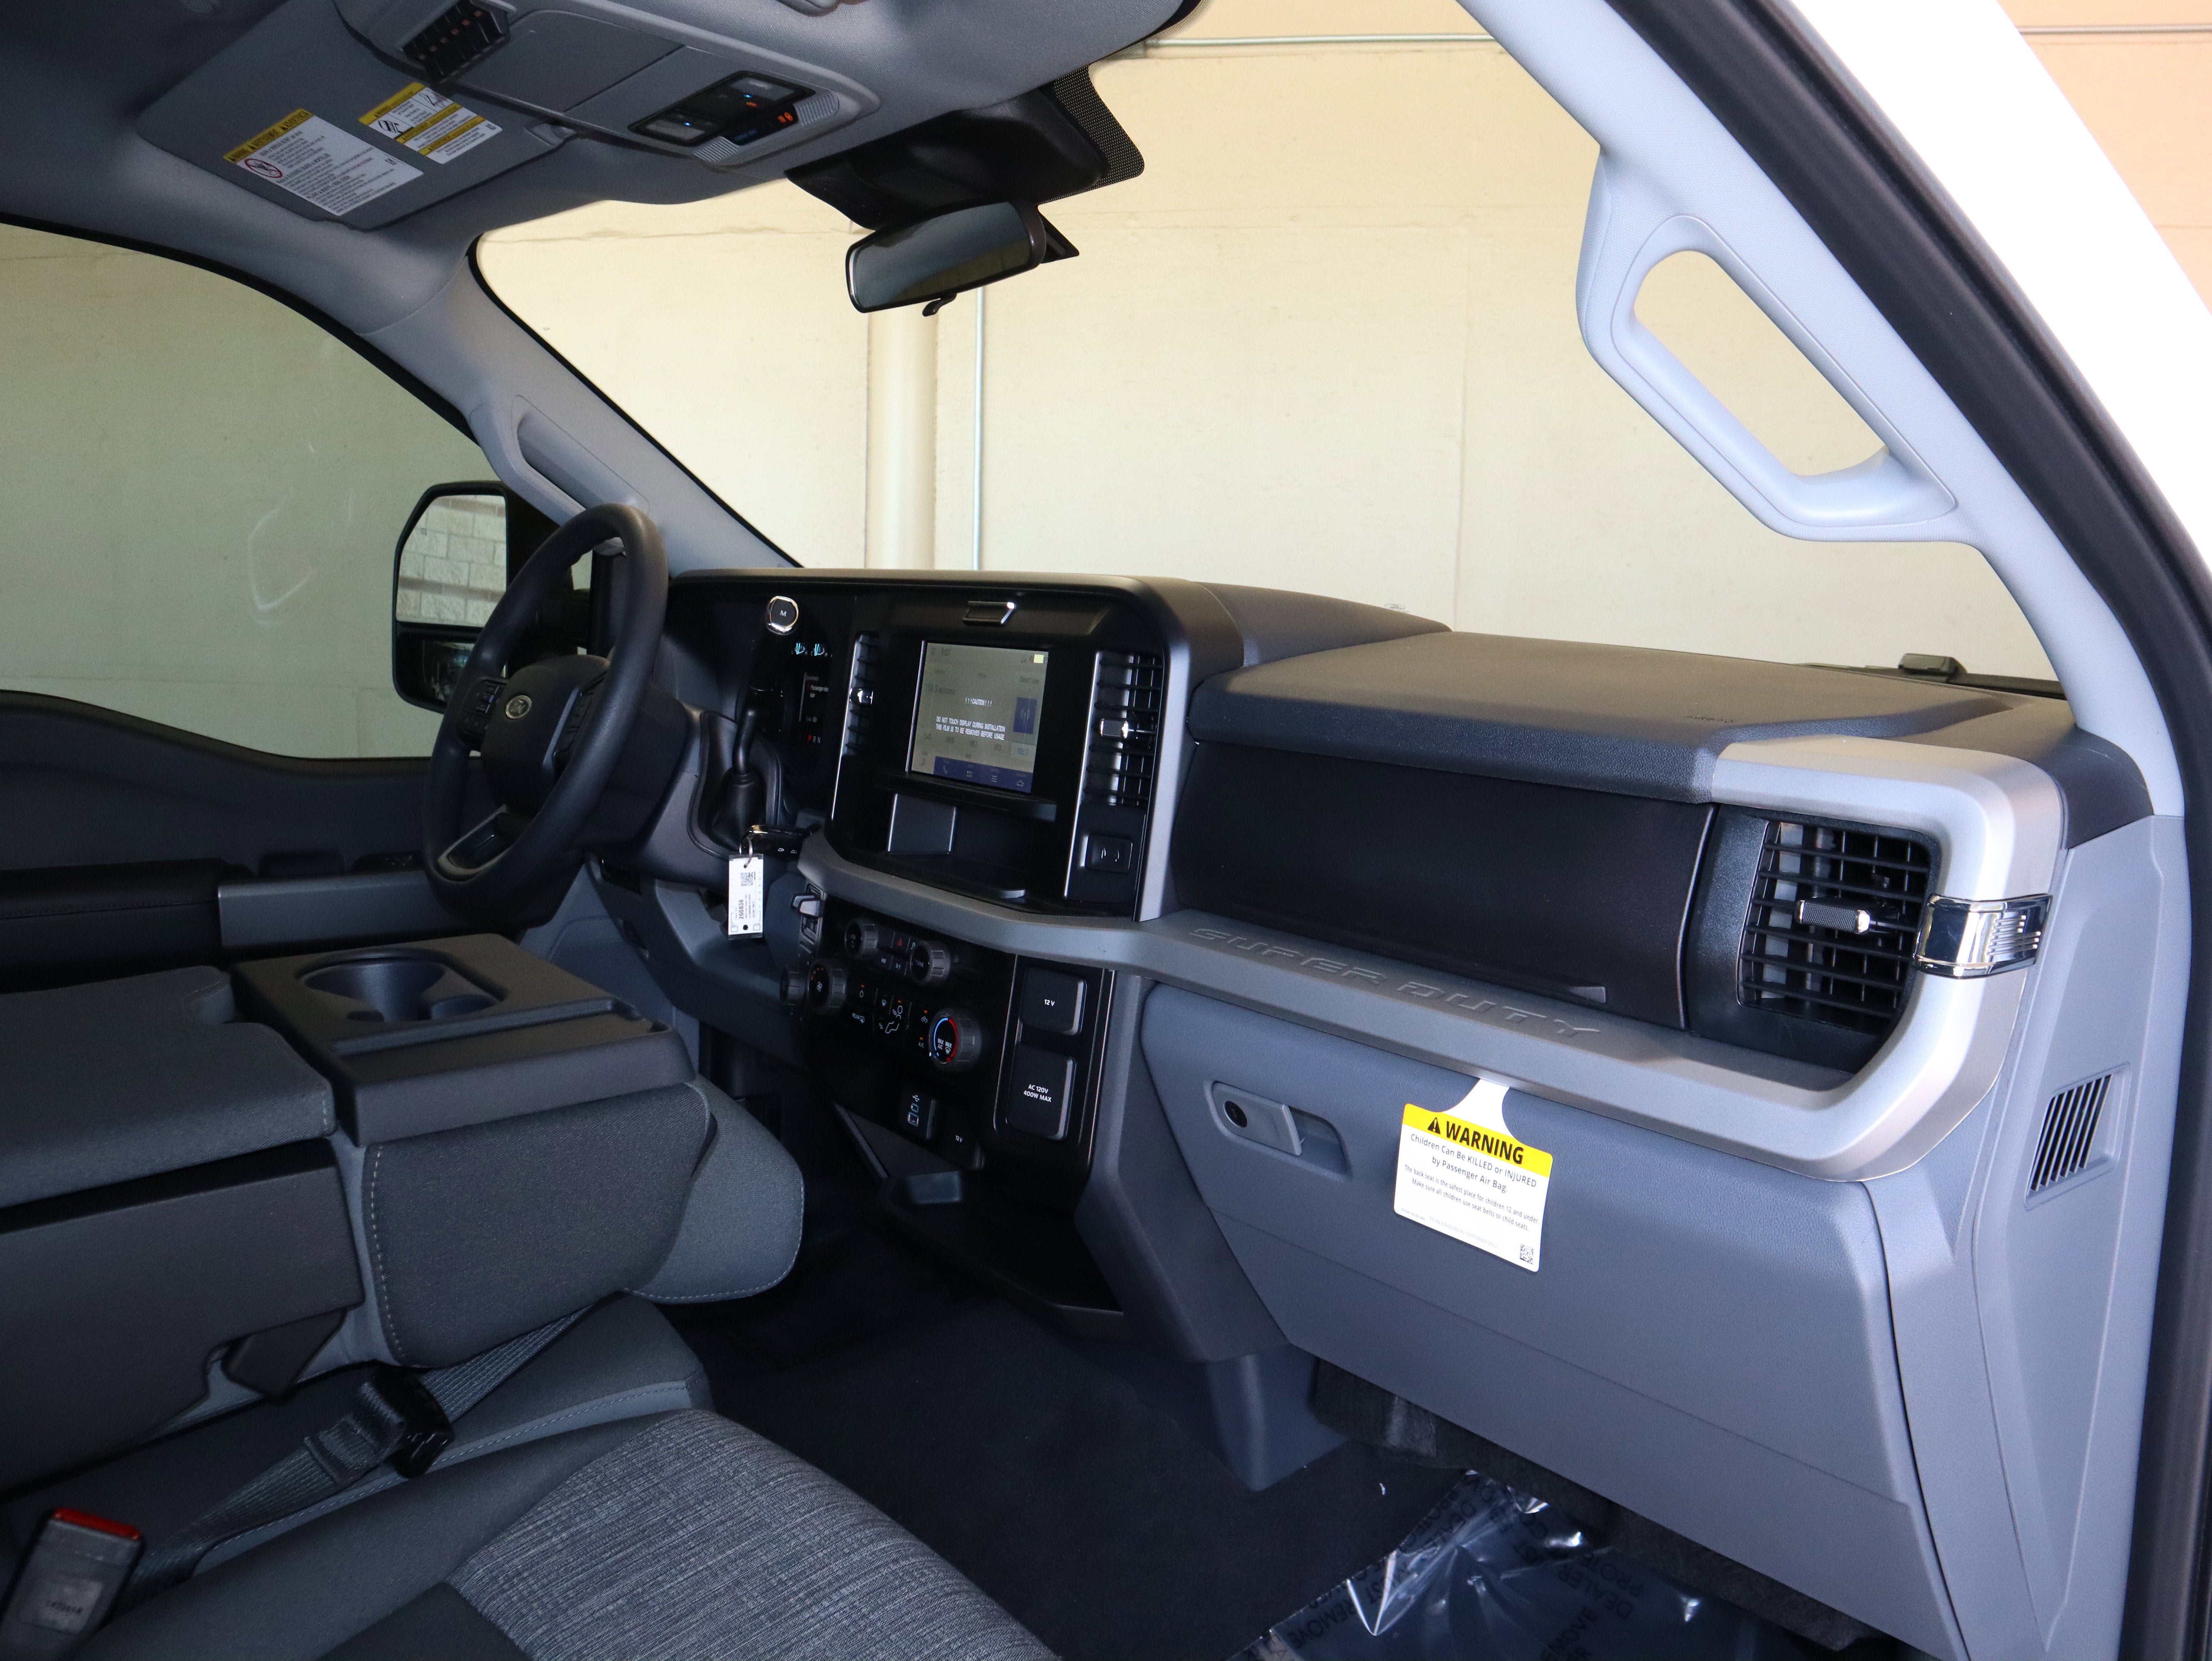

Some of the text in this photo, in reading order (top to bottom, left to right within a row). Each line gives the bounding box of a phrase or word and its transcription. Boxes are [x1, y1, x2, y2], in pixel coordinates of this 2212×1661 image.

[965, 728, 980, 736] REMOVED
[981, 730, 993, 739] BEFORE
[984, 722, 1006, 732] INSTALLATION
[1189, 927, 1601, 1038] SUPER DUTY
[1023, 1090, 1052, 1102] 400W MAX
[1411, 1134, 1439, 1150] Children
[1441, 1146, 1454, 1156] Can
[1456, 1151, 1466, 1161] Be
[1468, 1155, 1493, 1171] KILLED
[1505, 1169, 1537, 1188] INJURED
[1446, 1120, 1524, 1165] WARNING
[1432, 1156, 1508, 1194] by Passenger Air Bag.
[1412, 1178, 1424, 1188] Make
[1426, 1185, 1435, 1193] sure
[1443, 1191, 1462, 1204] children
[1472, 1203, 1482, 1213] seat
[1483, 1205, 1495, 1218] belts
[1502, 1215, 1514, 1225] child
[1515, 1221, 1529, 1232] seats.
[1414, 1168, 1424, 1178] back
[1425, 1173, 1434, 1182] seat
[1449, 1183, 1463, 1193] safest
[1463, 1189, 1476, 1200] place
[1485, 1196, 1505, 1210] children
[1513, 1208, 1522, 1218] and
[1524, 1213, 1539, 1225] under.
[1441, 1221, 1460, 1233] REMOVED
[1466, 1231, 1487, 1244] CUSTOMER
[1488, 1241, 1499, 1249] ONLY
